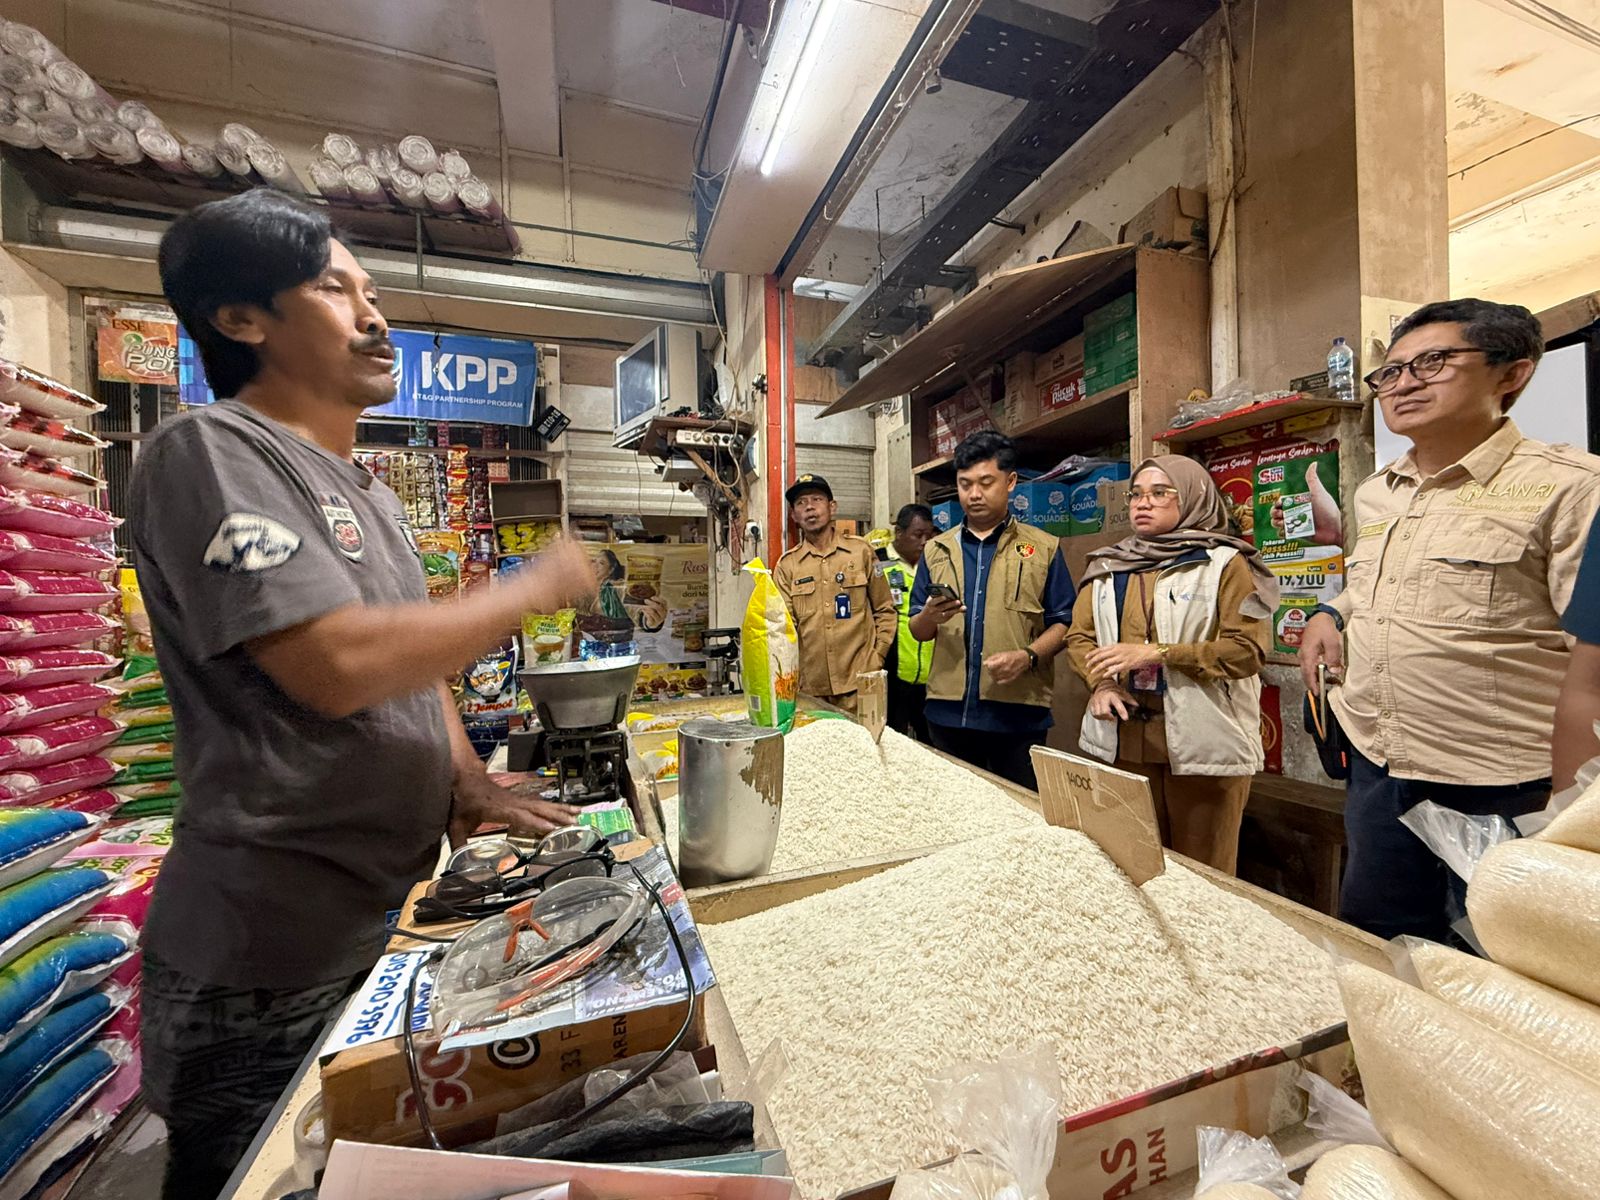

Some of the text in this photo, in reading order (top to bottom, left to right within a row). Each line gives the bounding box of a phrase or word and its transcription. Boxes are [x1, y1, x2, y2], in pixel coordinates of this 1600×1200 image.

[111, 318, 145, 331] ESSE
[129, 344, 178, 358] PUNC
[421, 351, 518, 394] KPP
[434, 394, 486, 405] PARTNERSHIP
[486, 399, 523, 409] PROGRAM
[1487, 483, 1557, 498] LAN RI
[1071, 499, 1098, 512] SQUAD
[612, 1014, 628, 1059] AREN
[1146, 1127, 1168, 1186] HAN
[1101, 1138, 1138, 1200] AS
